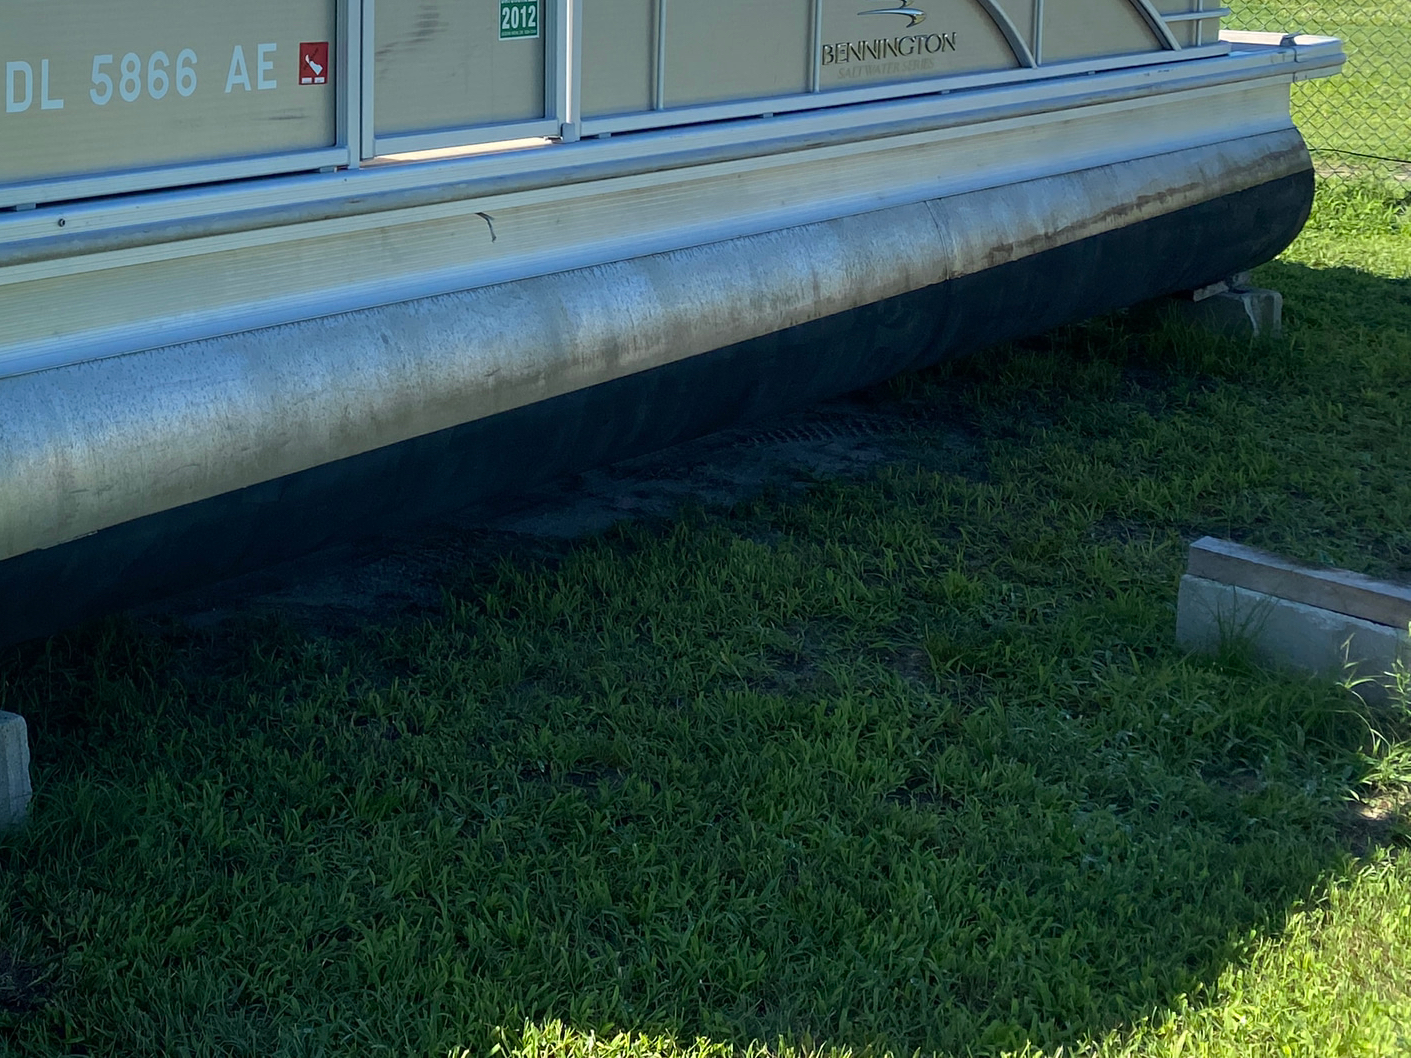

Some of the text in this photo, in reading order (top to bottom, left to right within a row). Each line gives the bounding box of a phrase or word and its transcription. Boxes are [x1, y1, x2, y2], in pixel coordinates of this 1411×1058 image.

[501, 5, 536, 29] 2012
[822, 32, 957, 66] BENNINGTON
[5, 59, 64, 113] DL
[89, 48, 198, 106] 5866
[224, 43, 277, 93] AE
[838, 58, 934, 79] SALTWATER SERIES
